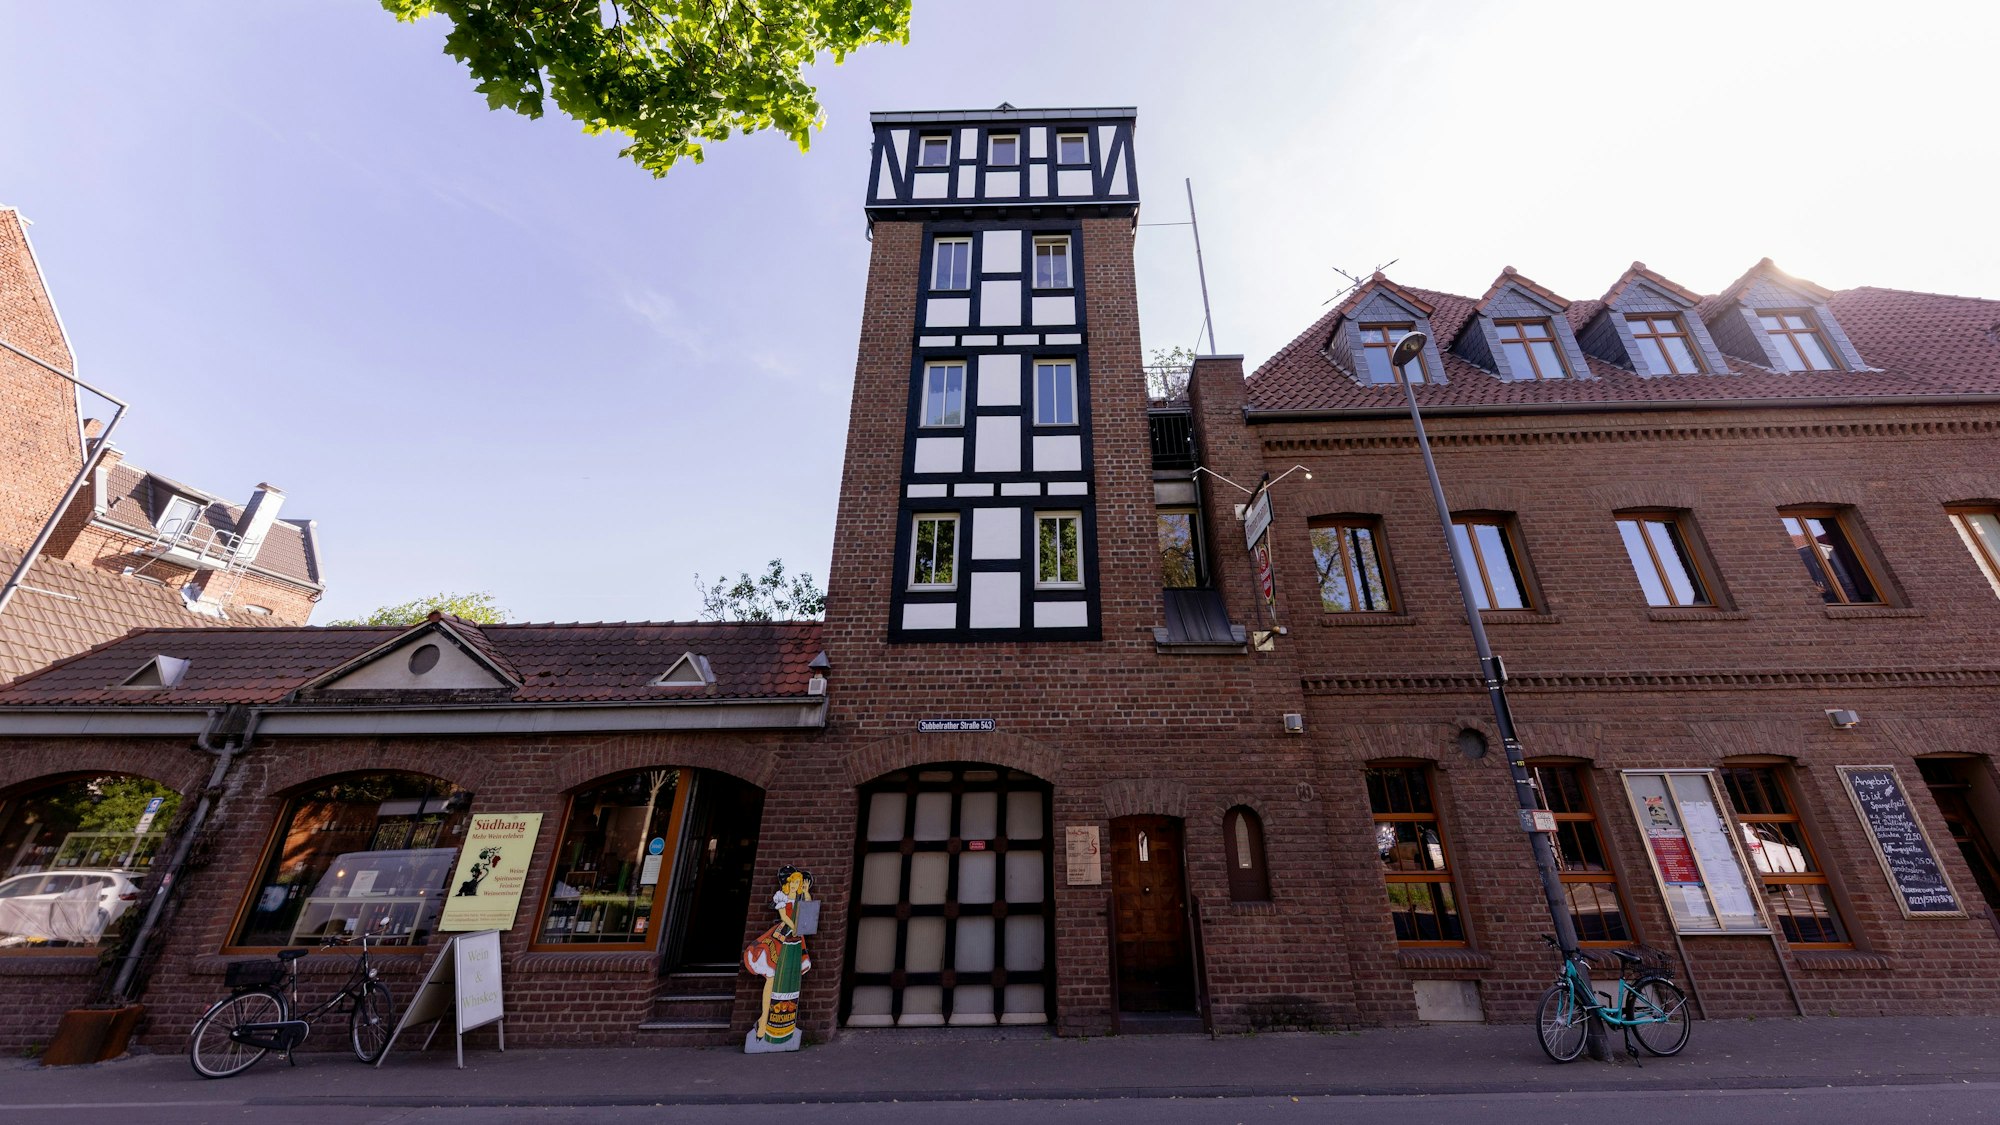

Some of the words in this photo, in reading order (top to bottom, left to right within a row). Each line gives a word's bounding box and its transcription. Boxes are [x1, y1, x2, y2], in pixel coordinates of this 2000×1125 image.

[921, 721, 959, 730] Subbelrather
[960, 721, 980, 730] Straße
[981, 721, 992, 730] 543
[1855, 774, 1890, 789] Angebot
[1859, 791, 1871, 801] Es
[1871, 791, 1883, 800] ist
[476, 819, 526, 832] Südhang
[467, 949, 489, 961] Wein
[475, 970, 483, 983] &
[463, 991, 497, 1008] Whiskey
